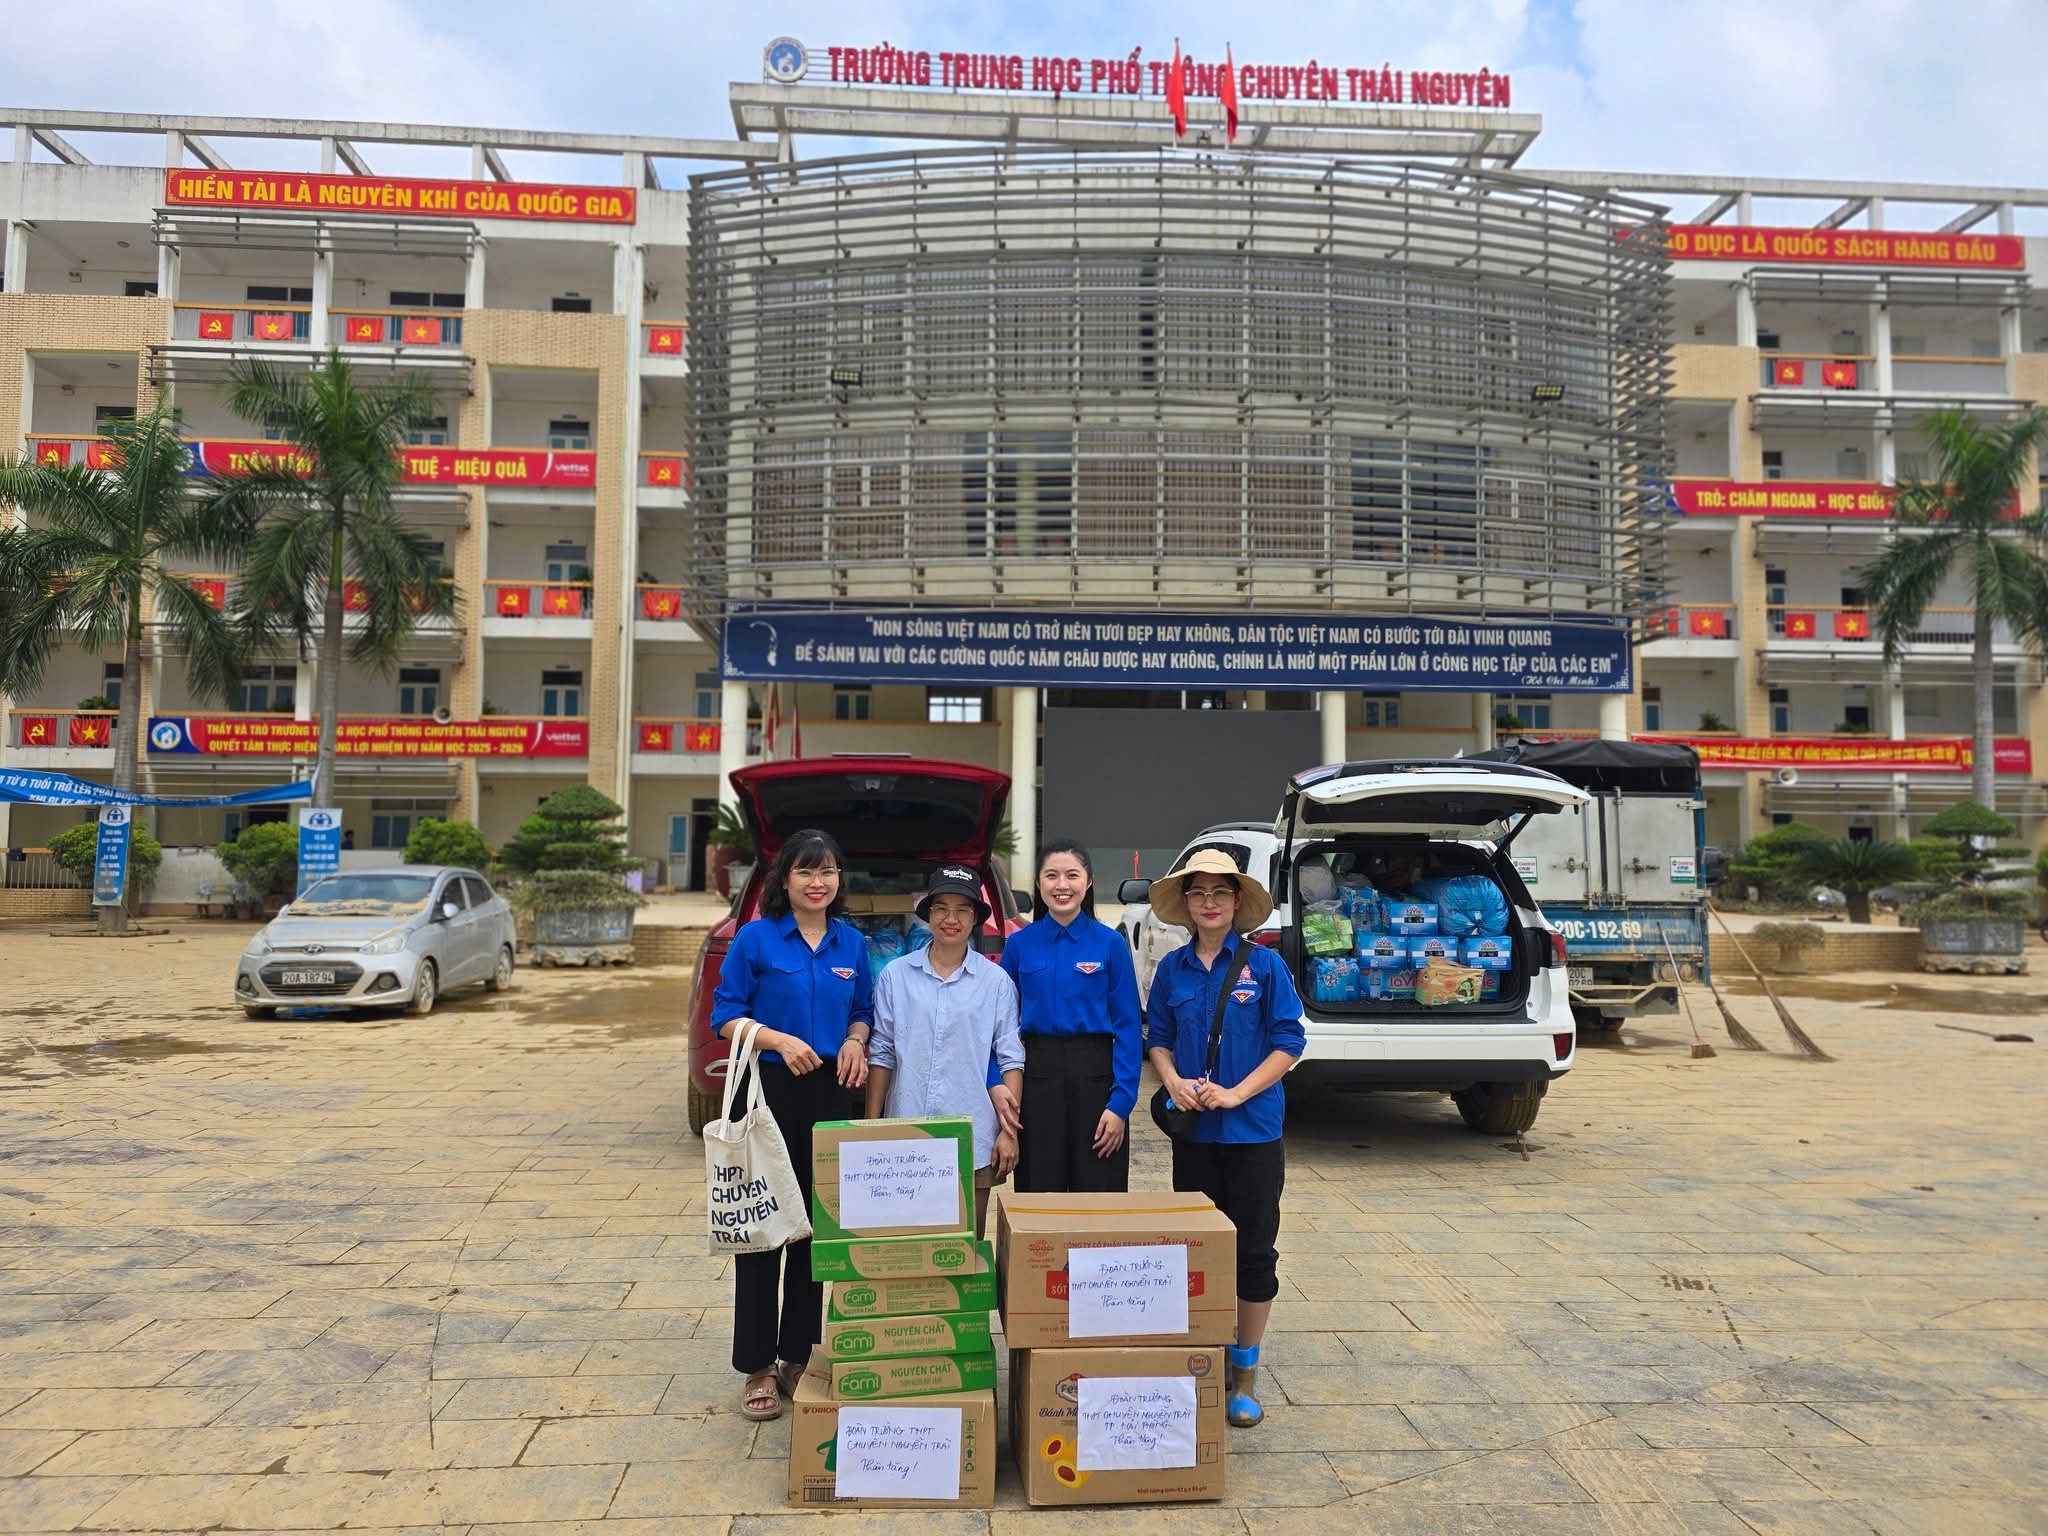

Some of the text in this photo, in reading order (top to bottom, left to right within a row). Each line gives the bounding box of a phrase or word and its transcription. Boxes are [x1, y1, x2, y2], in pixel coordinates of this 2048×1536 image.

[828, 41, 930, 86] TRƯỜNG
[939, 52, 1023, 90] TRUNG
[1032, 57, 1082, 100] HỌC
[1091, 46, 1142, 94] PHỐ
[1240, 59, 1338, 102] CHUYÊN
[1346, 62, 1404, 104] THÁI
[1411, 67, 1510, 107] NGUYÊN
[178, 174, 623, 217] HIỀN TÀI LÀ NGUYÊN KHÍ CỦA QUỐC GIA
[1695, 229, 1996, 262] DỤC LÀ QUỐC SÁCH HÀNG ĐẦU
[410, 458, 439, 479] TUỆ
[455, 459, 491, 480] HIỆU
[495, 456, 527, 478] QUẢ
[1771, 492, 1816, 508] NGOAN
[1828, 493, 1855, 512] HỌC
[906, 618, 943, 638] SÔNG
[947, 619, 975, 642] VIỆT
[978, 621, 1009, 639] NAM
[1013, 620, 1031, 640] CÓ
[1035, 619, 1059, 641] TRỞ
[1063, 621, 1091, 641] NÊN
[1094, 623, 1124, 642] TƯƠI
[1128, 626, 1153, 644] ĐẸP
[1157, 626, 1181, 642] HAY
[1185, 623, 1235, 645] KHÔNG,
[1238, 624, 1266, 643] DÂN
[1269, 625, 1294, 647] TỘC
[1298, 624, 1325, 647] VIỆT
[1329, 627, 1360, 644] NAM
[1364, 625, 1381, 644] CÓ
[1385, 625, 1420, 645] BƯỚC
[1424, 625, 1444, 646] TỚI
[1448, 626, 1470, 646] ĐÀI
[1473, 629, 1504, 647] VINH
[1508, 629, 1552, 648] QUANG
[817, 643, 855, 663] SÁNH
[859, 647, 880, 663] VAI
[883, 645, 905, 664] VỚI
[909, 644, 936, 664] CÁC
[940, 645, 985, 666] CƯỜNG
[989, 645, 1025, 667] QUỐC
[1028, 648, 1059, 667] NĂM
[1063, 649, 1099, 668] CHÂU
[1103, 652, 1138, 671] ĐƯỢC
[1142, 652, 1167, 669] HAY
[1170, 650, 1220, 671] KHÔNG,
[1223, 651, 1264, 670] CHÍNH
[1268, 651, 1286, 670] LÀ
[1288, 651, 1316, 671] NHỜ
[1319, 652, 1347, 675] MỘT
[1351, 650, 1387, 671] PHẦN
[1390, 652, 1416, 672] LỚN
[1420, 650, 1430, 672] Ở
[1433, 652, 1468, 673] CÔNG
[1472, 656, 1498, 676] HỌC
[1502, 653, 1527, 677] TẬP
[1531, 652, 1557, 673] CỦA
[1561, 653, 1587, 673] CÁC
[713, 1163, 745, 1183] THPT
[712, 1227, 751, 1244] TRÃI
